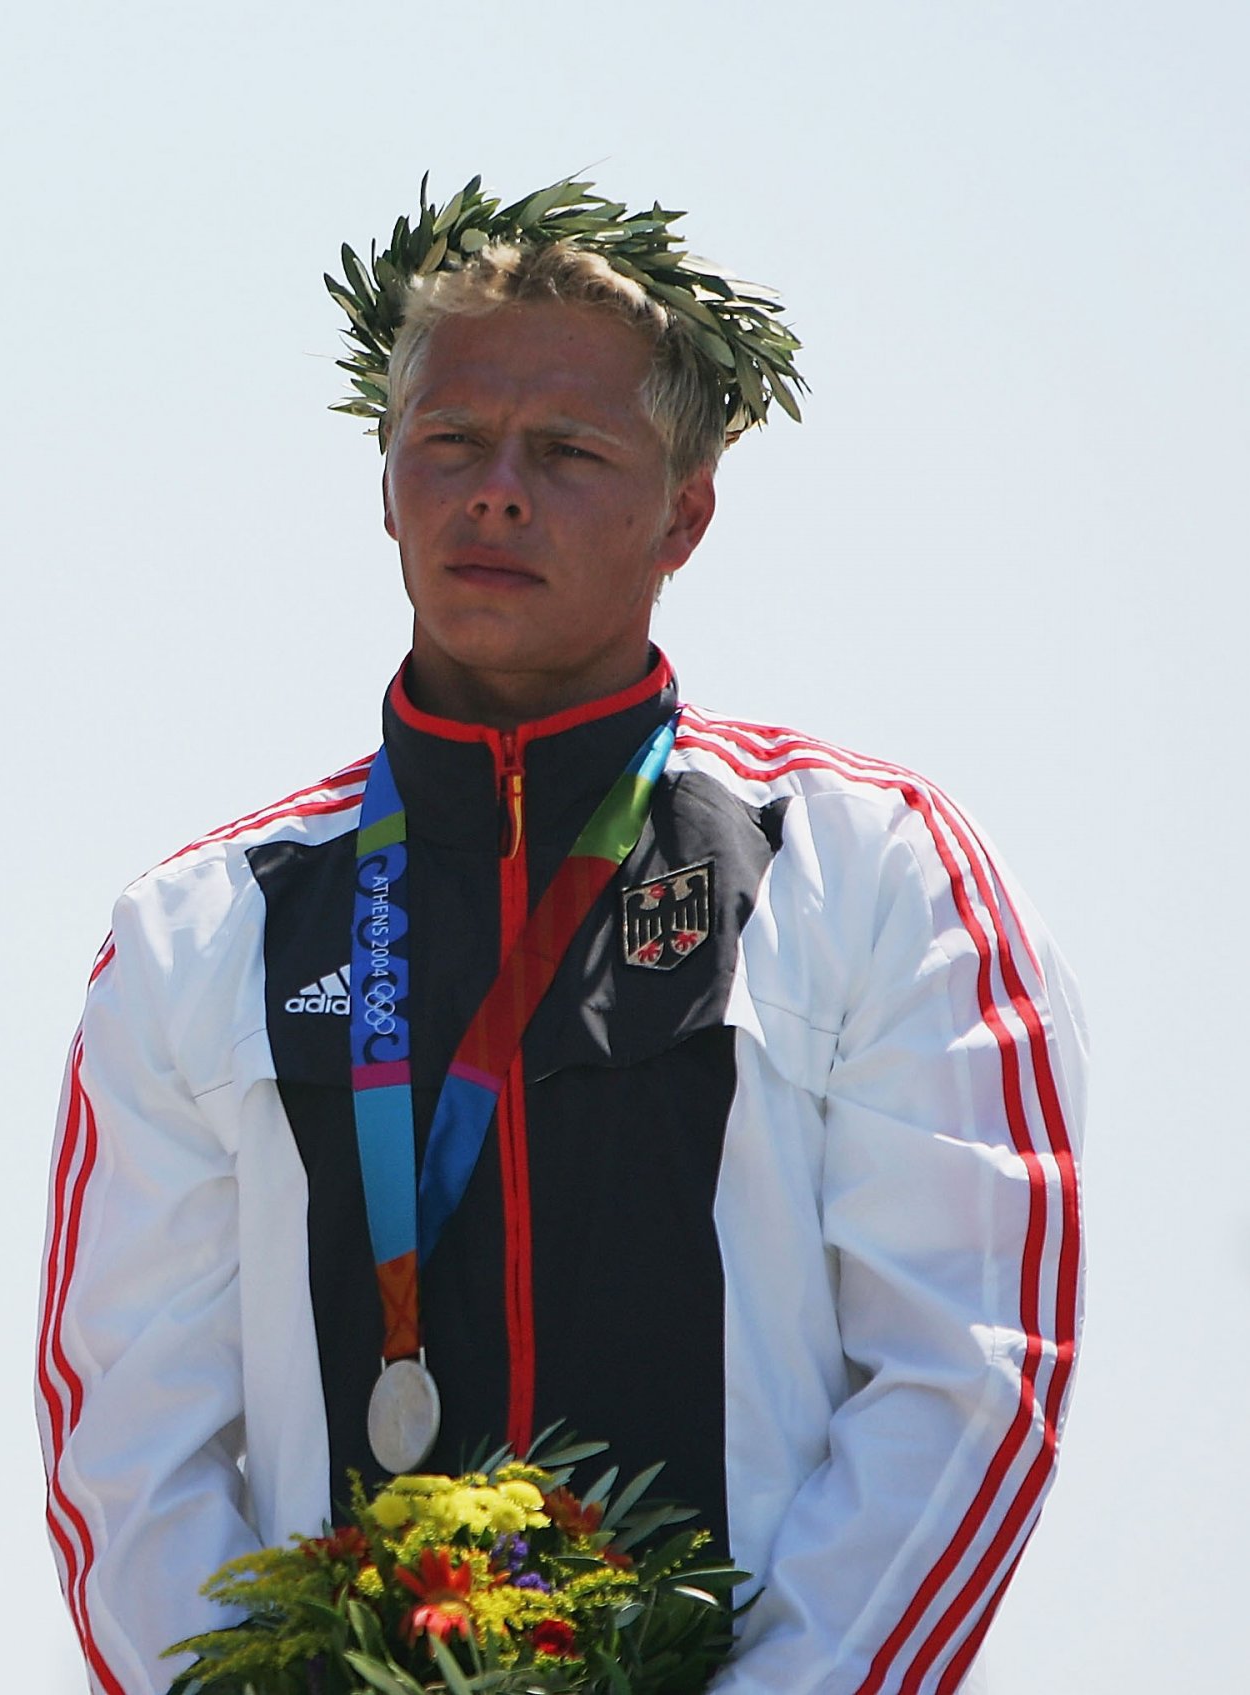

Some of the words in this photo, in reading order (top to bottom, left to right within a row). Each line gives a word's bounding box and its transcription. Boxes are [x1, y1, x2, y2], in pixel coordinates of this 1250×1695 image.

[371, 876, 390, 936] ATHENS
[370, 939, 390, 977] 2004
[284, 993, 351, 1016] adid
